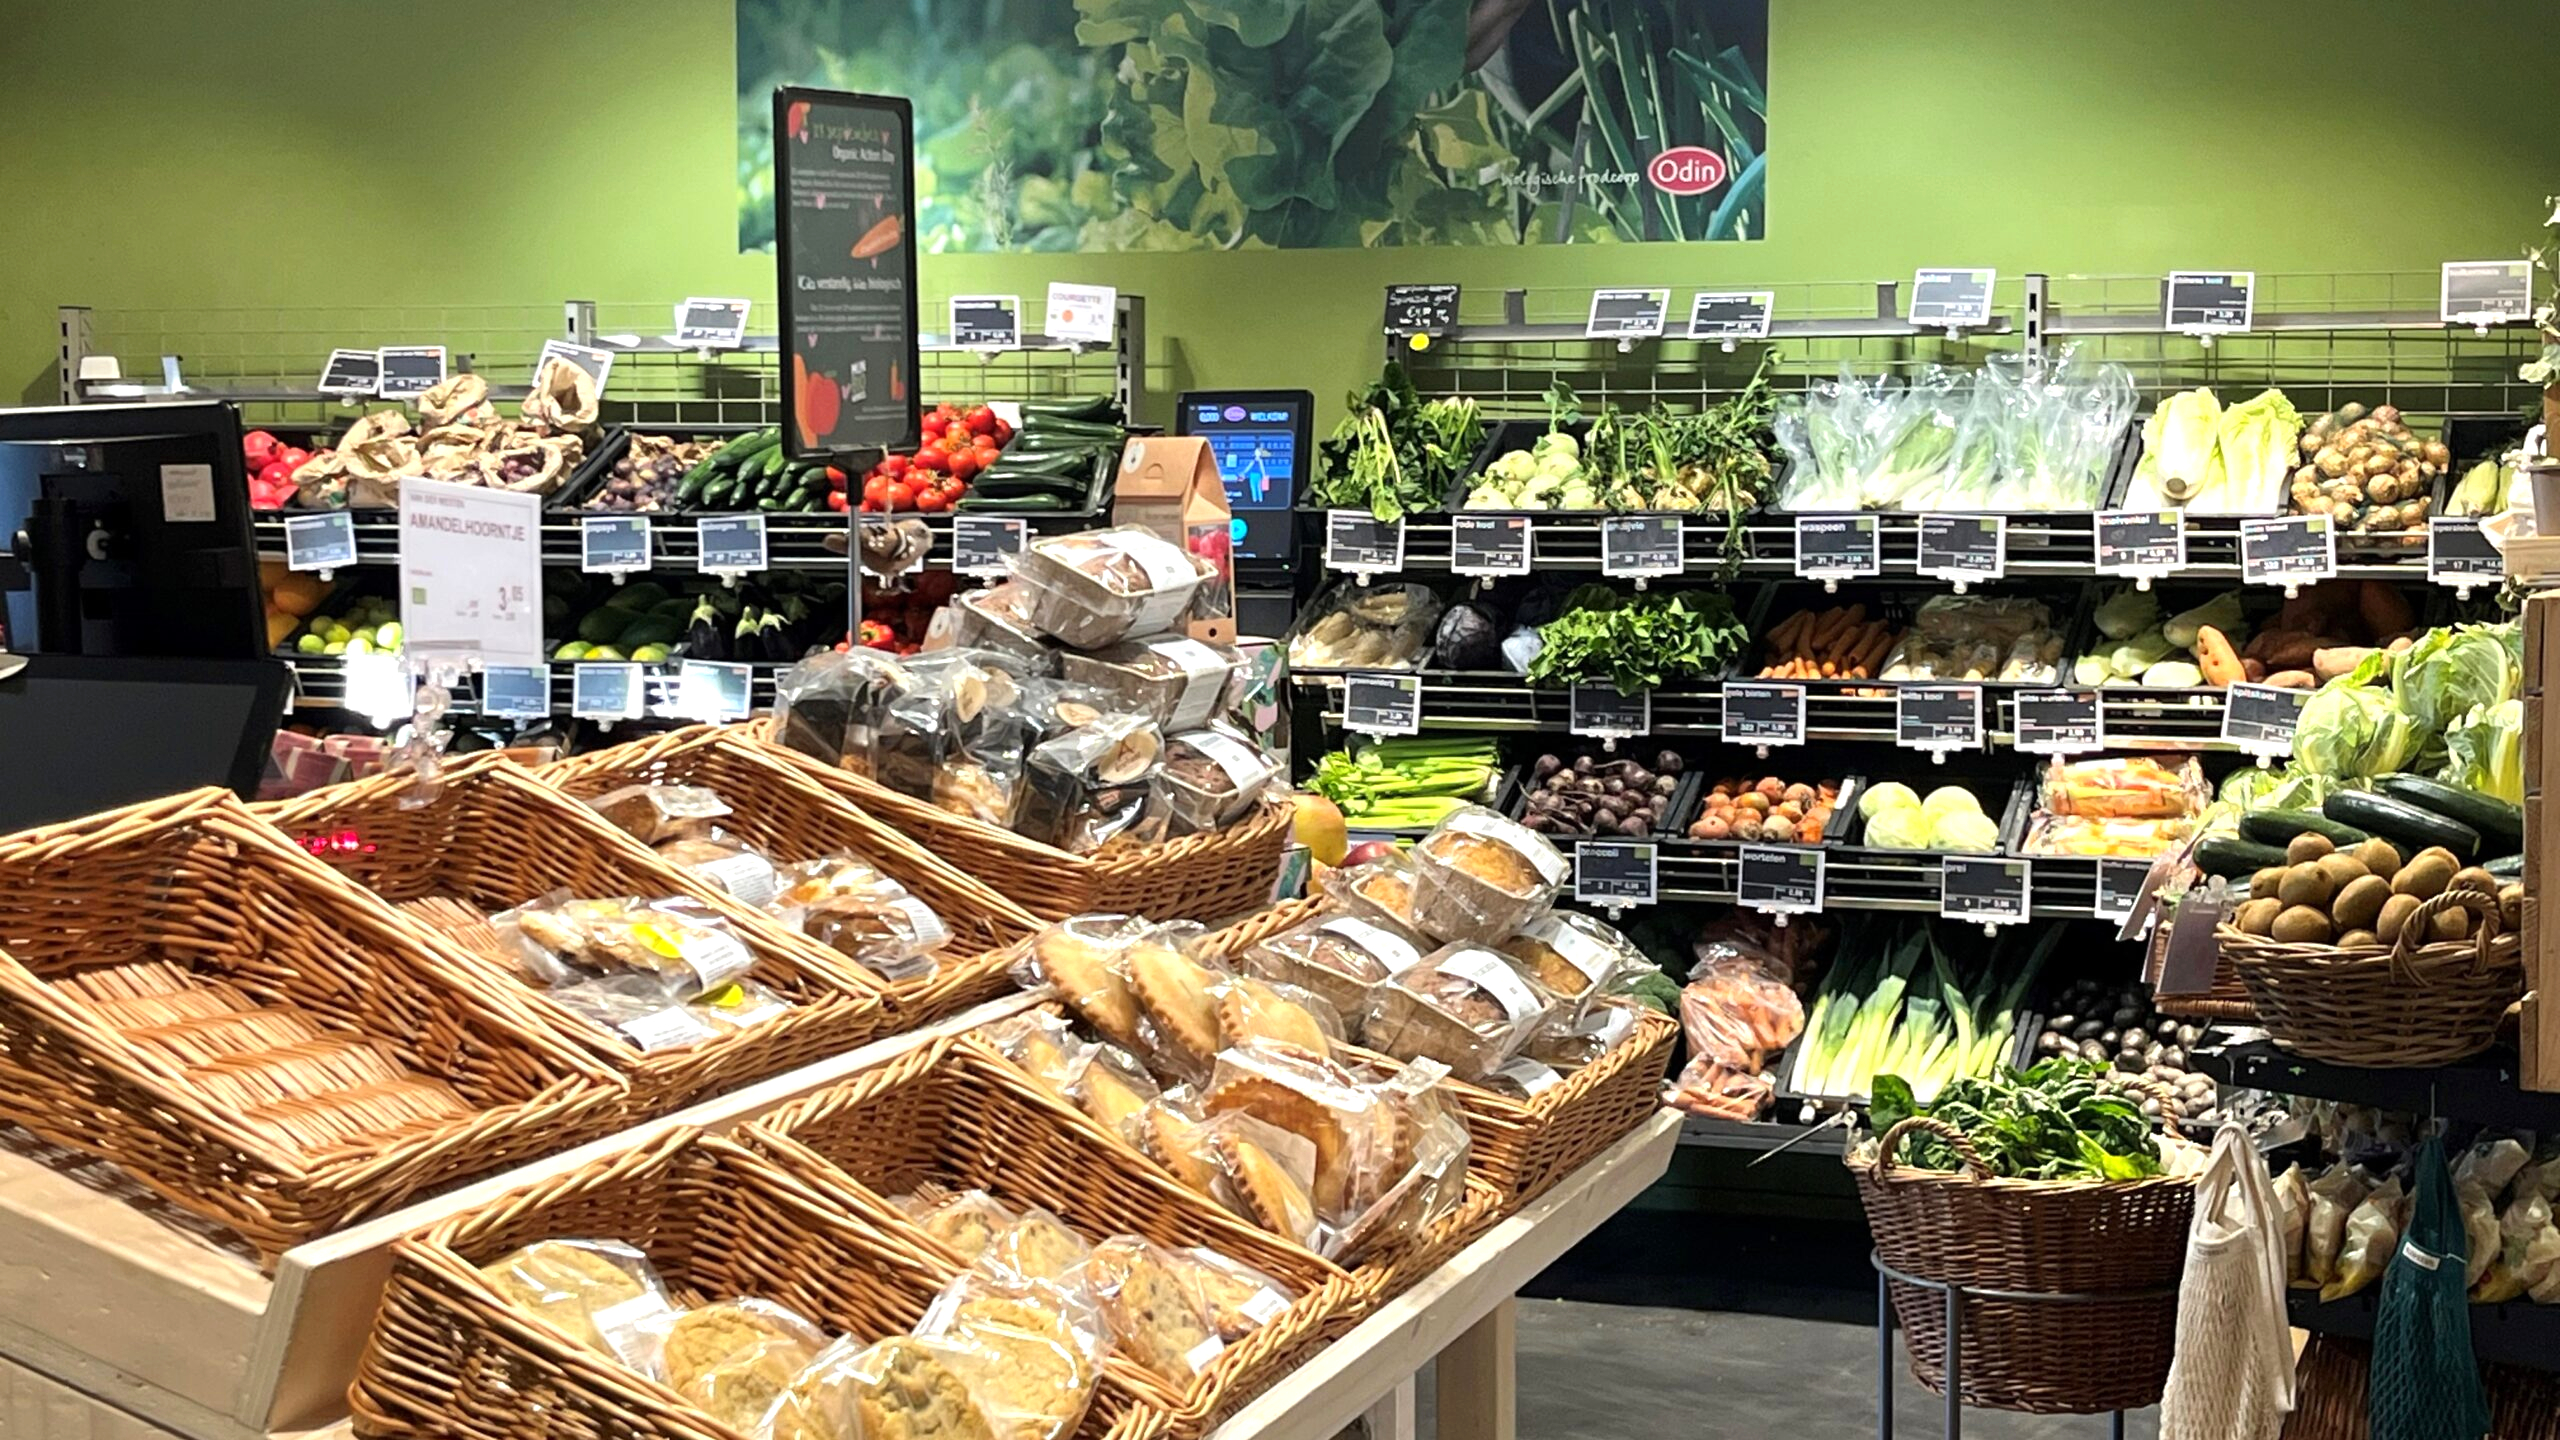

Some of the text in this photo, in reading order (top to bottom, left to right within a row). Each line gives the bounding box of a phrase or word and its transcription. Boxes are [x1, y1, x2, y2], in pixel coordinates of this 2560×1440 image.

[832, 144, 858, 162] Organic
[1656, 157, 1716, 184] Odin
[1053, 292, 1102, 305] COURGETTE
[410, 512, 526, 542] AMANDELHOORNTJE
[1476, 521, 1496, 529] kool
[1800, 523, 1846, 534] waspeen
[2232, 688, 2277, 702] spitskool
[1580, 847, 1619, 857] broccoli
[1743, 852, 1786, 863] wortelen
[1945, 864, 1967, 873] prei
